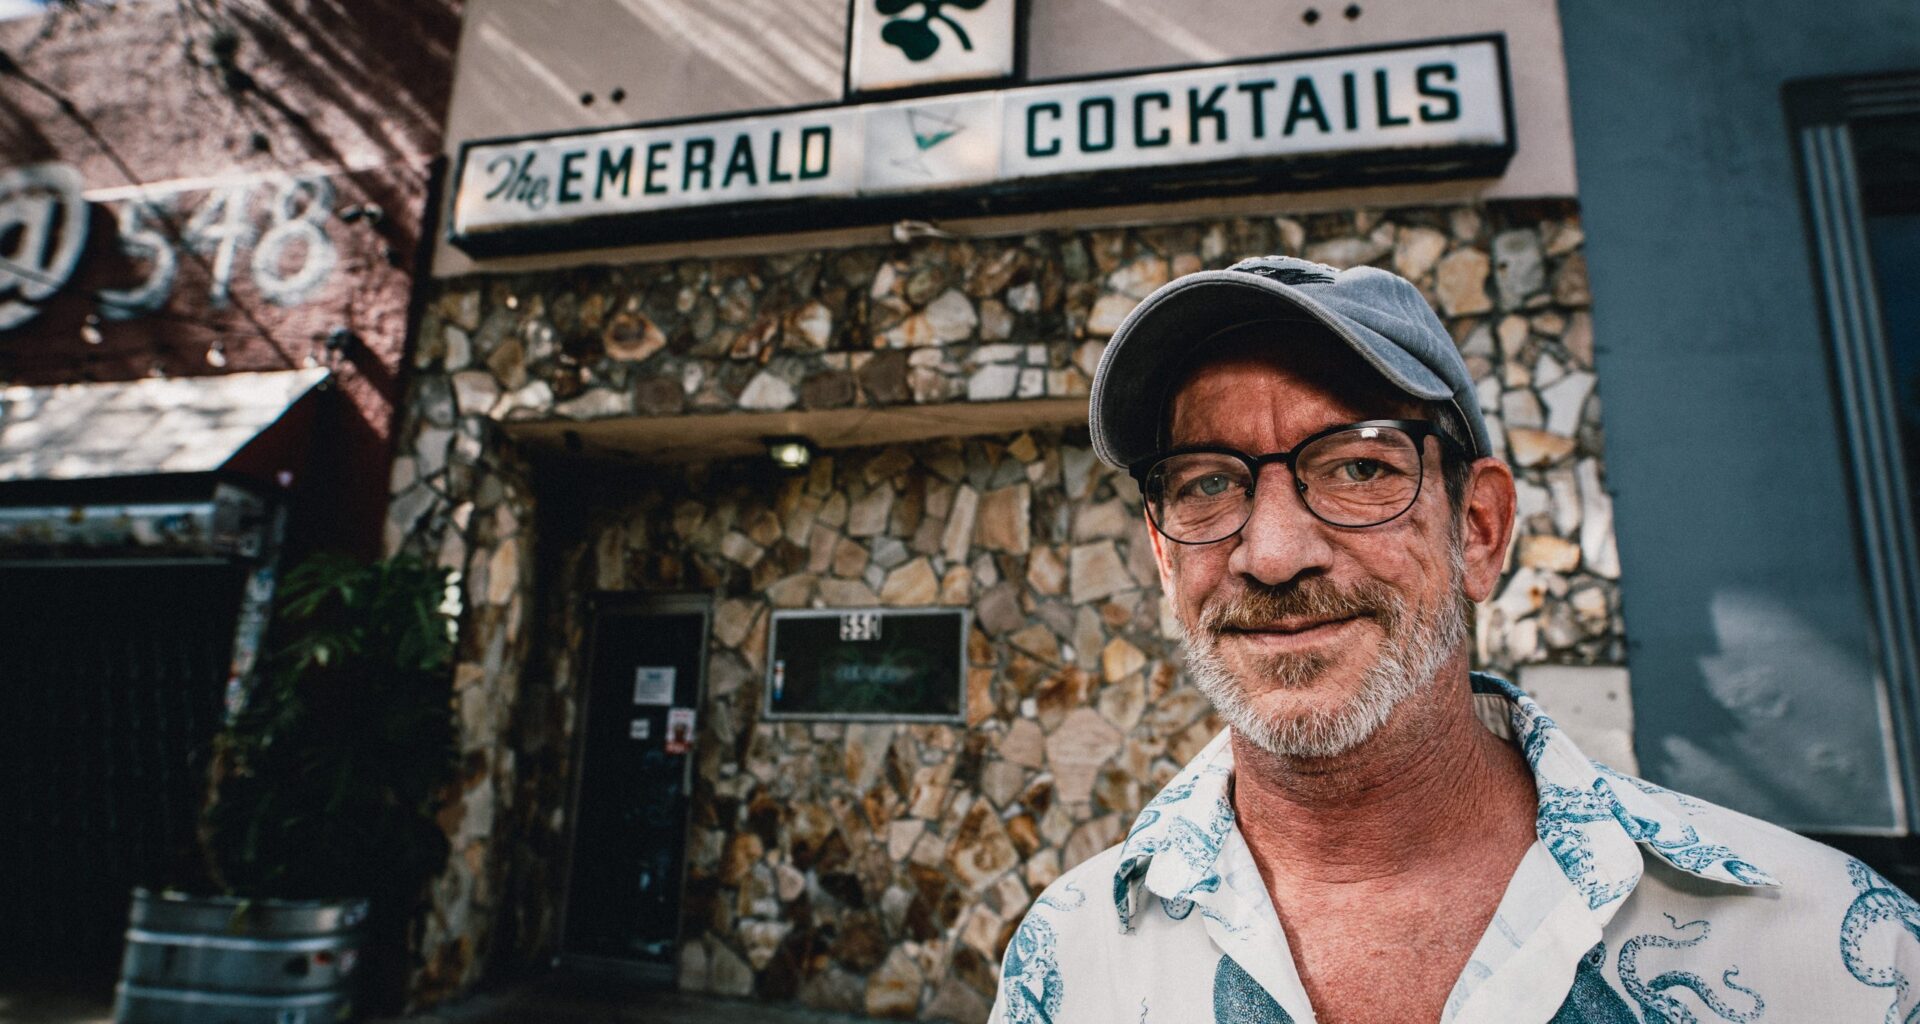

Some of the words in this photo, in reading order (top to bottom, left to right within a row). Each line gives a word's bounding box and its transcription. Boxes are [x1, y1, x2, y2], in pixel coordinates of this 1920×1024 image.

[485, 150, 549, 211] The
[557, 126, 832, 203] EMERALD
[1026, 63, 1461, 158] COCKTAILS
